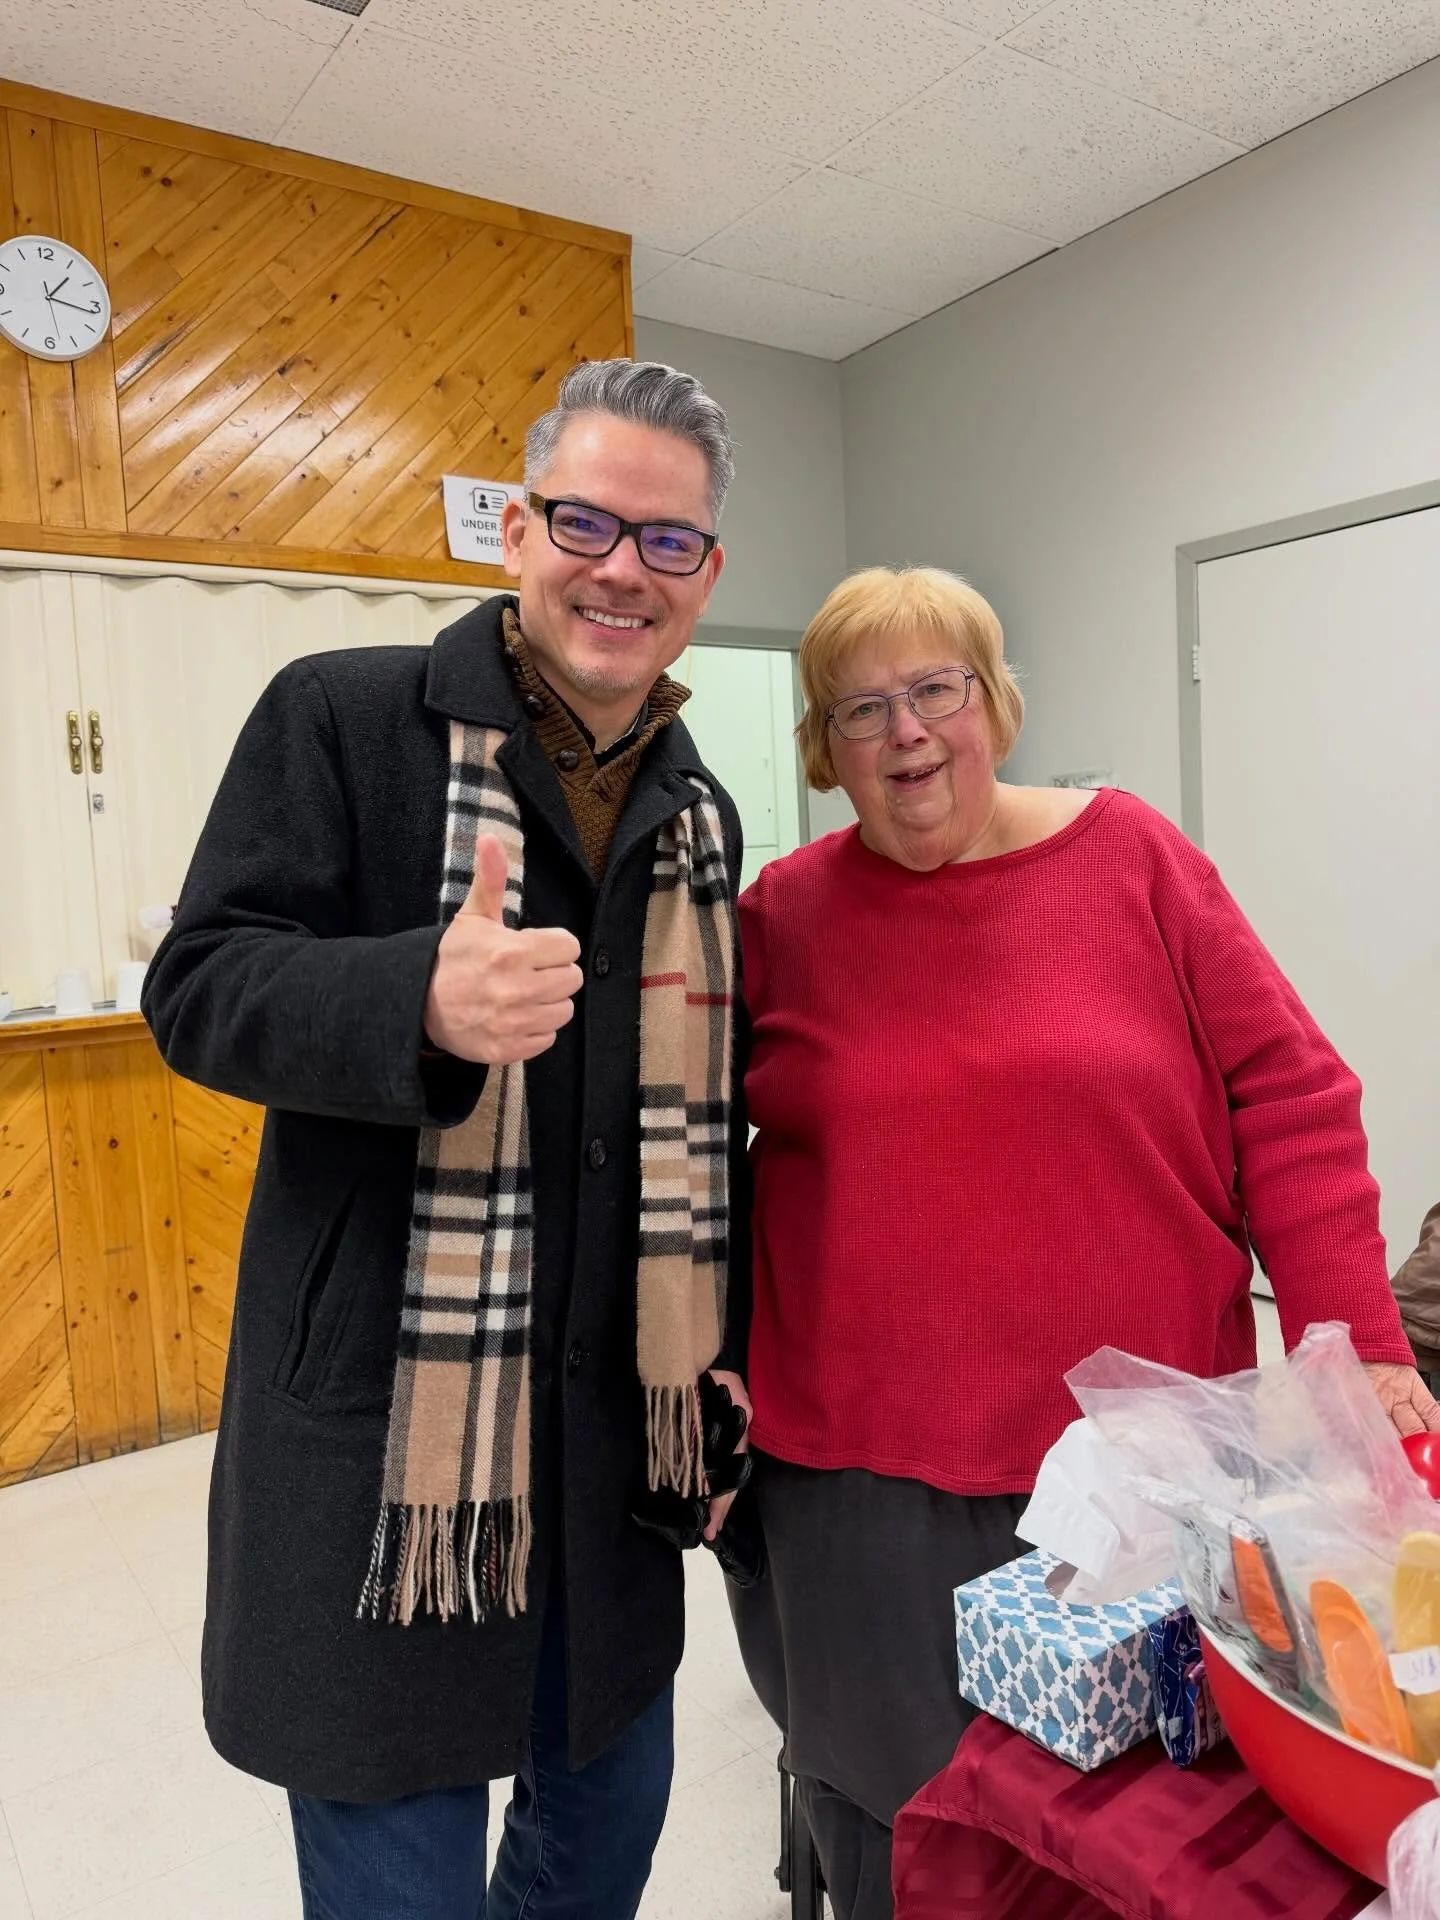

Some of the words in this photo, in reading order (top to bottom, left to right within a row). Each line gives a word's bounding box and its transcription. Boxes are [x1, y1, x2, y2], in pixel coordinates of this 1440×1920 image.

[37, 246, 55, 261] 12
[90, 300, 102, 314] 3
[44, 336, 56, 350] 6
[461, 518, 498, 533] UNDER
